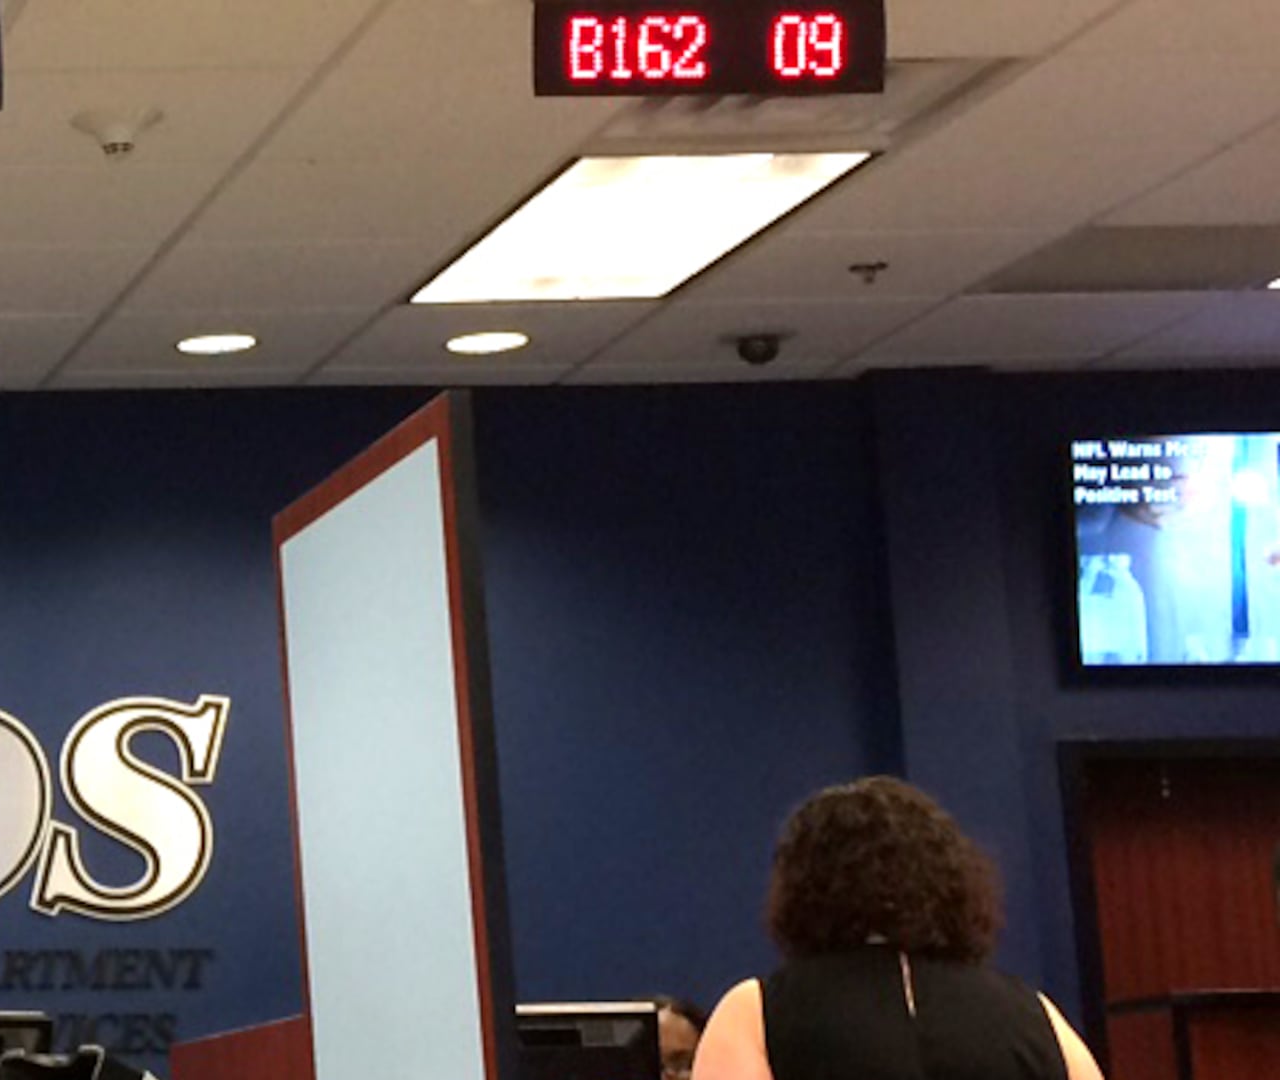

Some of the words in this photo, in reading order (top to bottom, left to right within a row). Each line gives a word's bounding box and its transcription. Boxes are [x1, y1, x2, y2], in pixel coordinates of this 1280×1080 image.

[569, 15, 707, 79] B162
[773, 13, 843, 77] 09
[1072, 441, 1107, 459] NFL
[1108, 440, 1161, 458] Warns
[1074, 464, 1107, 484] May
[1111, 463, 1150, 481] Lead
[1154, 464, 1173, 481] to
[1074, 486, 1139, 503] Positive
